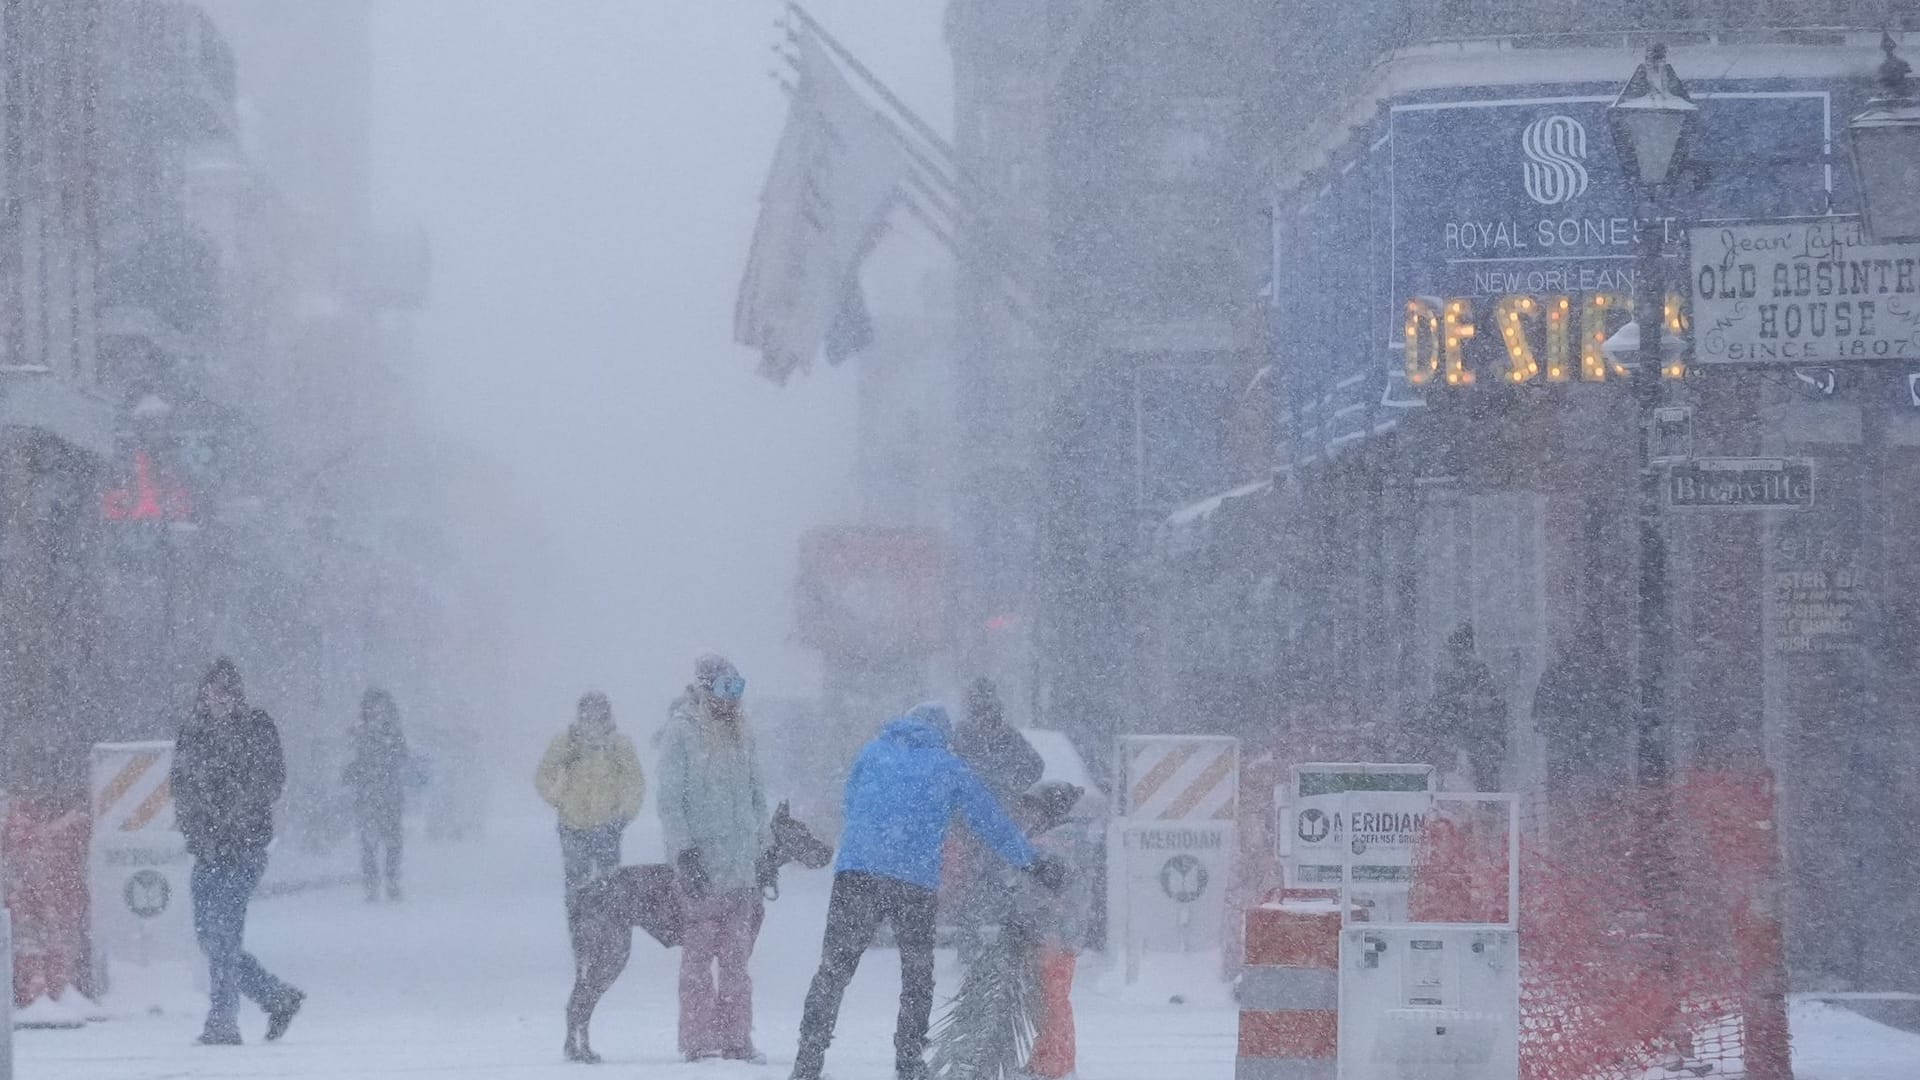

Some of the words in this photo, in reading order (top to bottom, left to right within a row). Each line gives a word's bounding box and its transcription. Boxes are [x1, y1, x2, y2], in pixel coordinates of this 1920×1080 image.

[1445, 221, 1527, 250] ROYAL
[1475, 271, 1519, 293] NEW
[1527, 268, 1642, 292] ORLEAN
[1700, 264, 1757, 300] OLD
[1773, 258, 1920, 298] ABSINTH
[1758, 300, 1876, 339] HOUSE
[1727, 341, 1819, 360] SINCE
[1839, 338, 1909, 356] 1807
[1677, 475, 1809, 500] Bienville
